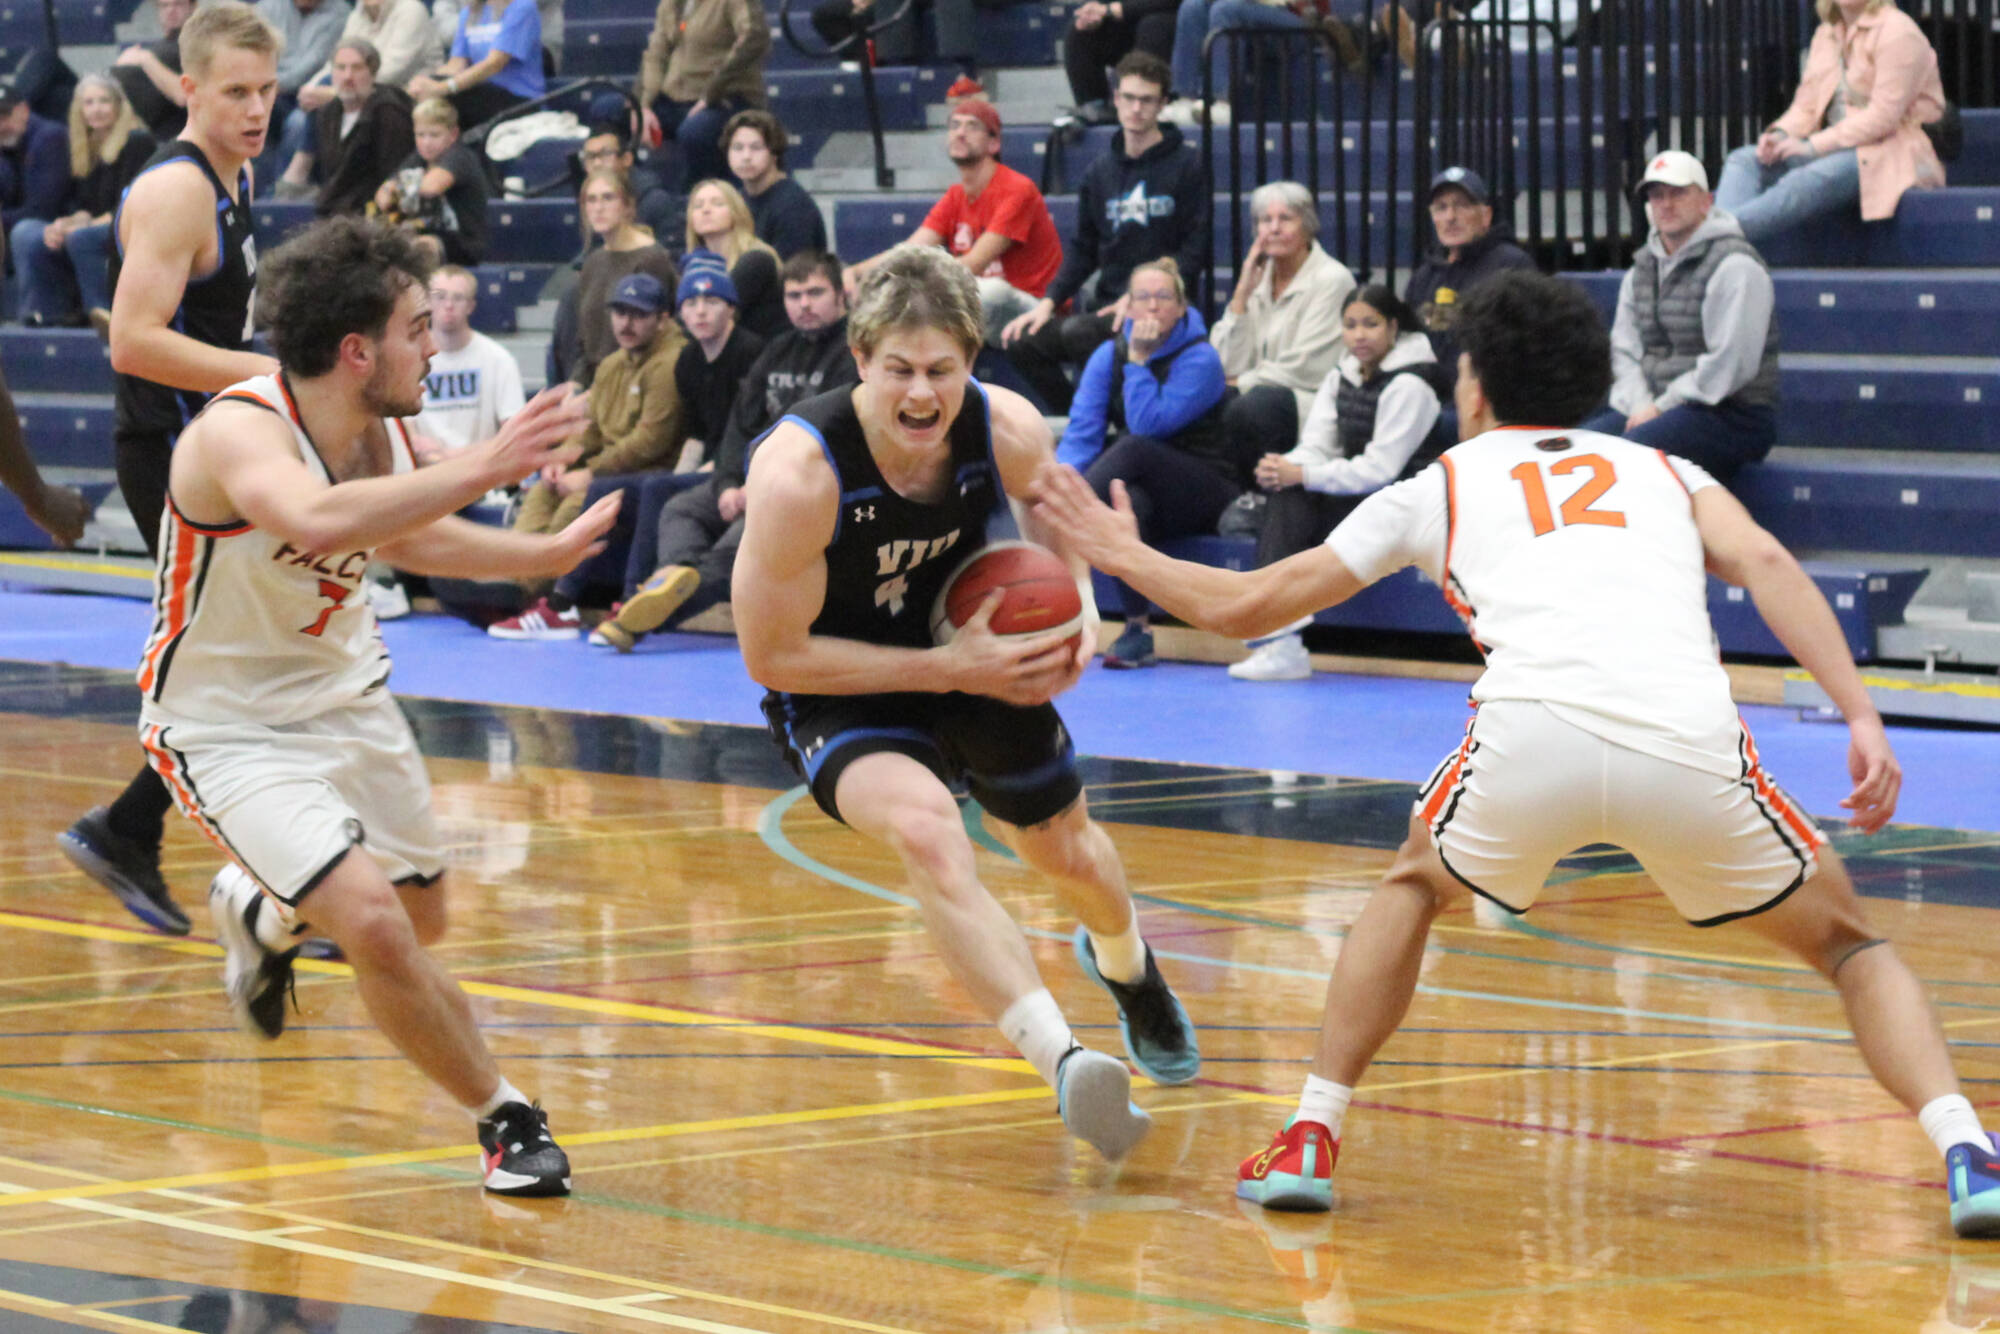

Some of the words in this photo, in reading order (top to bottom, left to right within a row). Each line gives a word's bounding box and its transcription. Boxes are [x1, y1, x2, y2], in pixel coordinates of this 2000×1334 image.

[425, 372, 477, 399] VIU
[1510, 453, 1626, 537] 12
[272, 543, 367, 584] FALC
[299, 579, 352, 637] 7
[874, 574, 909, 617] 4
